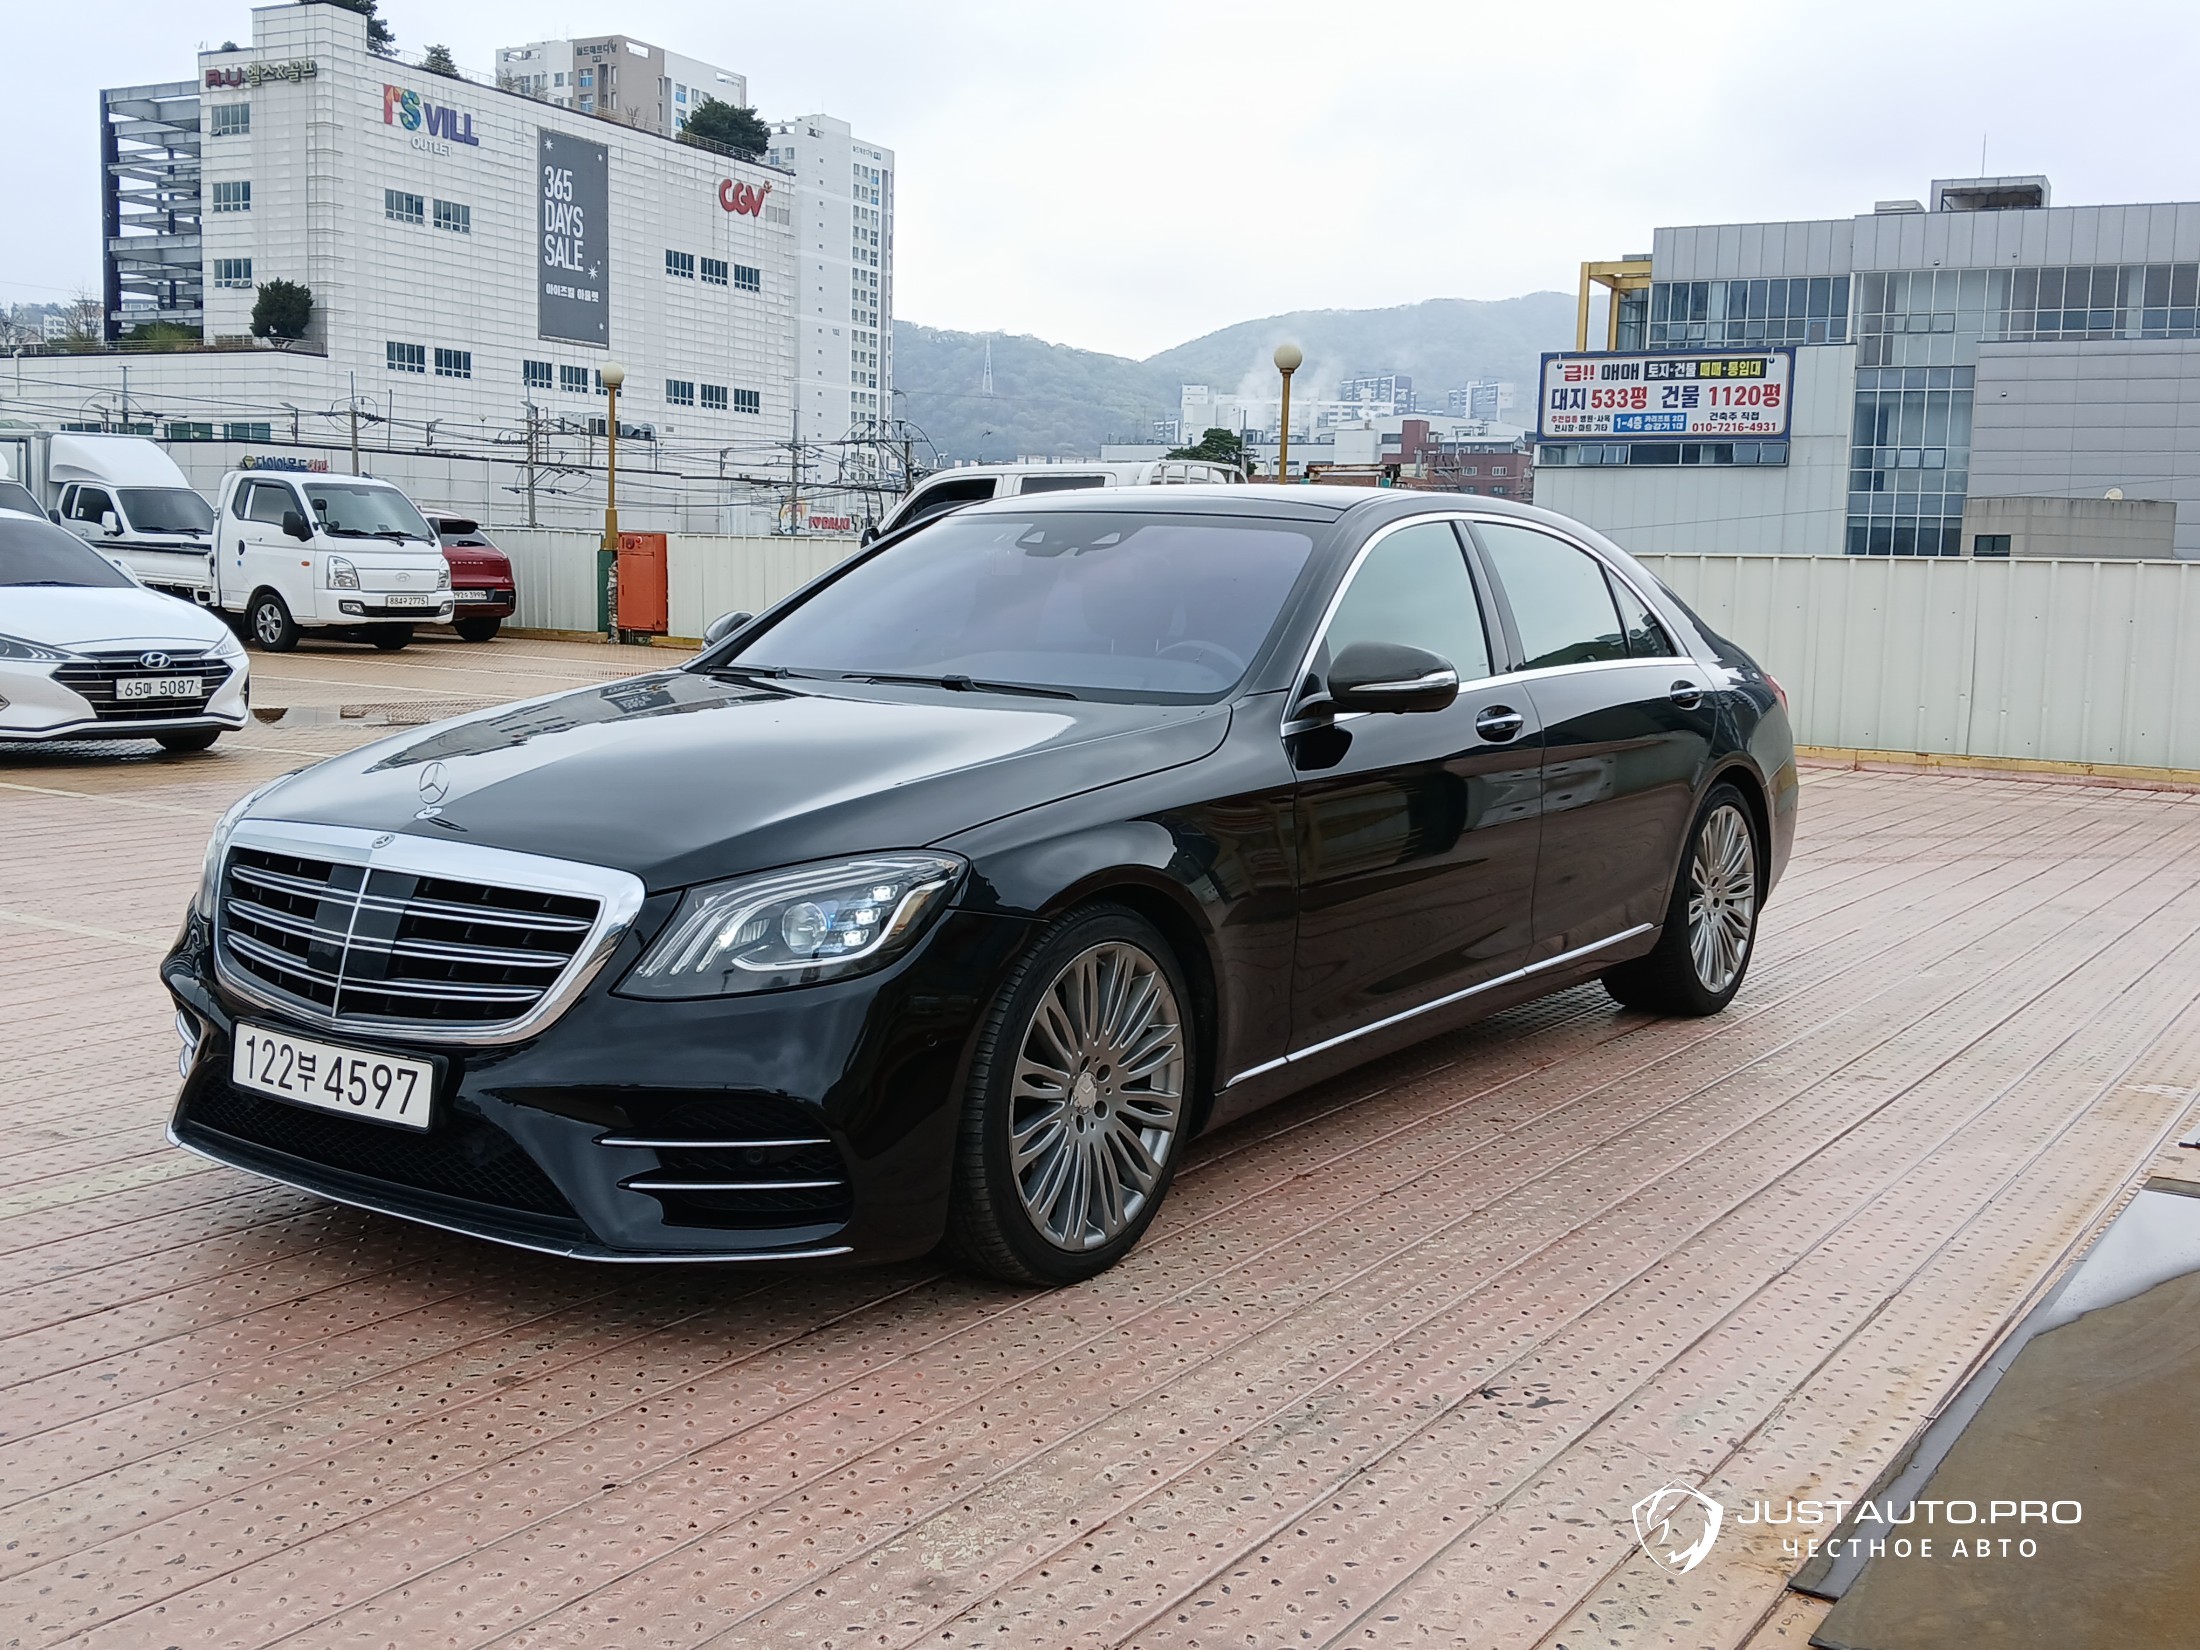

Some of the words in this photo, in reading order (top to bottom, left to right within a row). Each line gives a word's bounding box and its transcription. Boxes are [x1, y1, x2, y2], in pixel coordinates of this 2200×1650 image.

[423, 101, 480, 146] VILL
[411, 136, 453, 157] OUTLET
[544, 165, 573, 202] 365
[719, 179, 765, 217] CGV
[544, 199, 584, 238] DAYS
[544, 234, 584, 272] SALE
[1564, 364, 1595, 382] 급!!
[1601, 363, 1639, 381] 매매
[1551, 388, 1587, 410] 대지
[1591, 386, 1648, 409] 533평
[1661, 385, 1700, 409] 건물
[1708, 383, 1782, 408] 1120평
[1672, 414, 1685, 422] 2대
[1709, 412, 1738, 421] 건축주
[1740, 411, 1760, 421] 직접
[1594, 423, 1608, 432] 기타
[1671, 422, 1684, 431] 1대
[1692, 422, 1777, 432] 010-7216-4931
[124, 682, 152, 696] 65마
[159, 680, 195, 695] 5087
